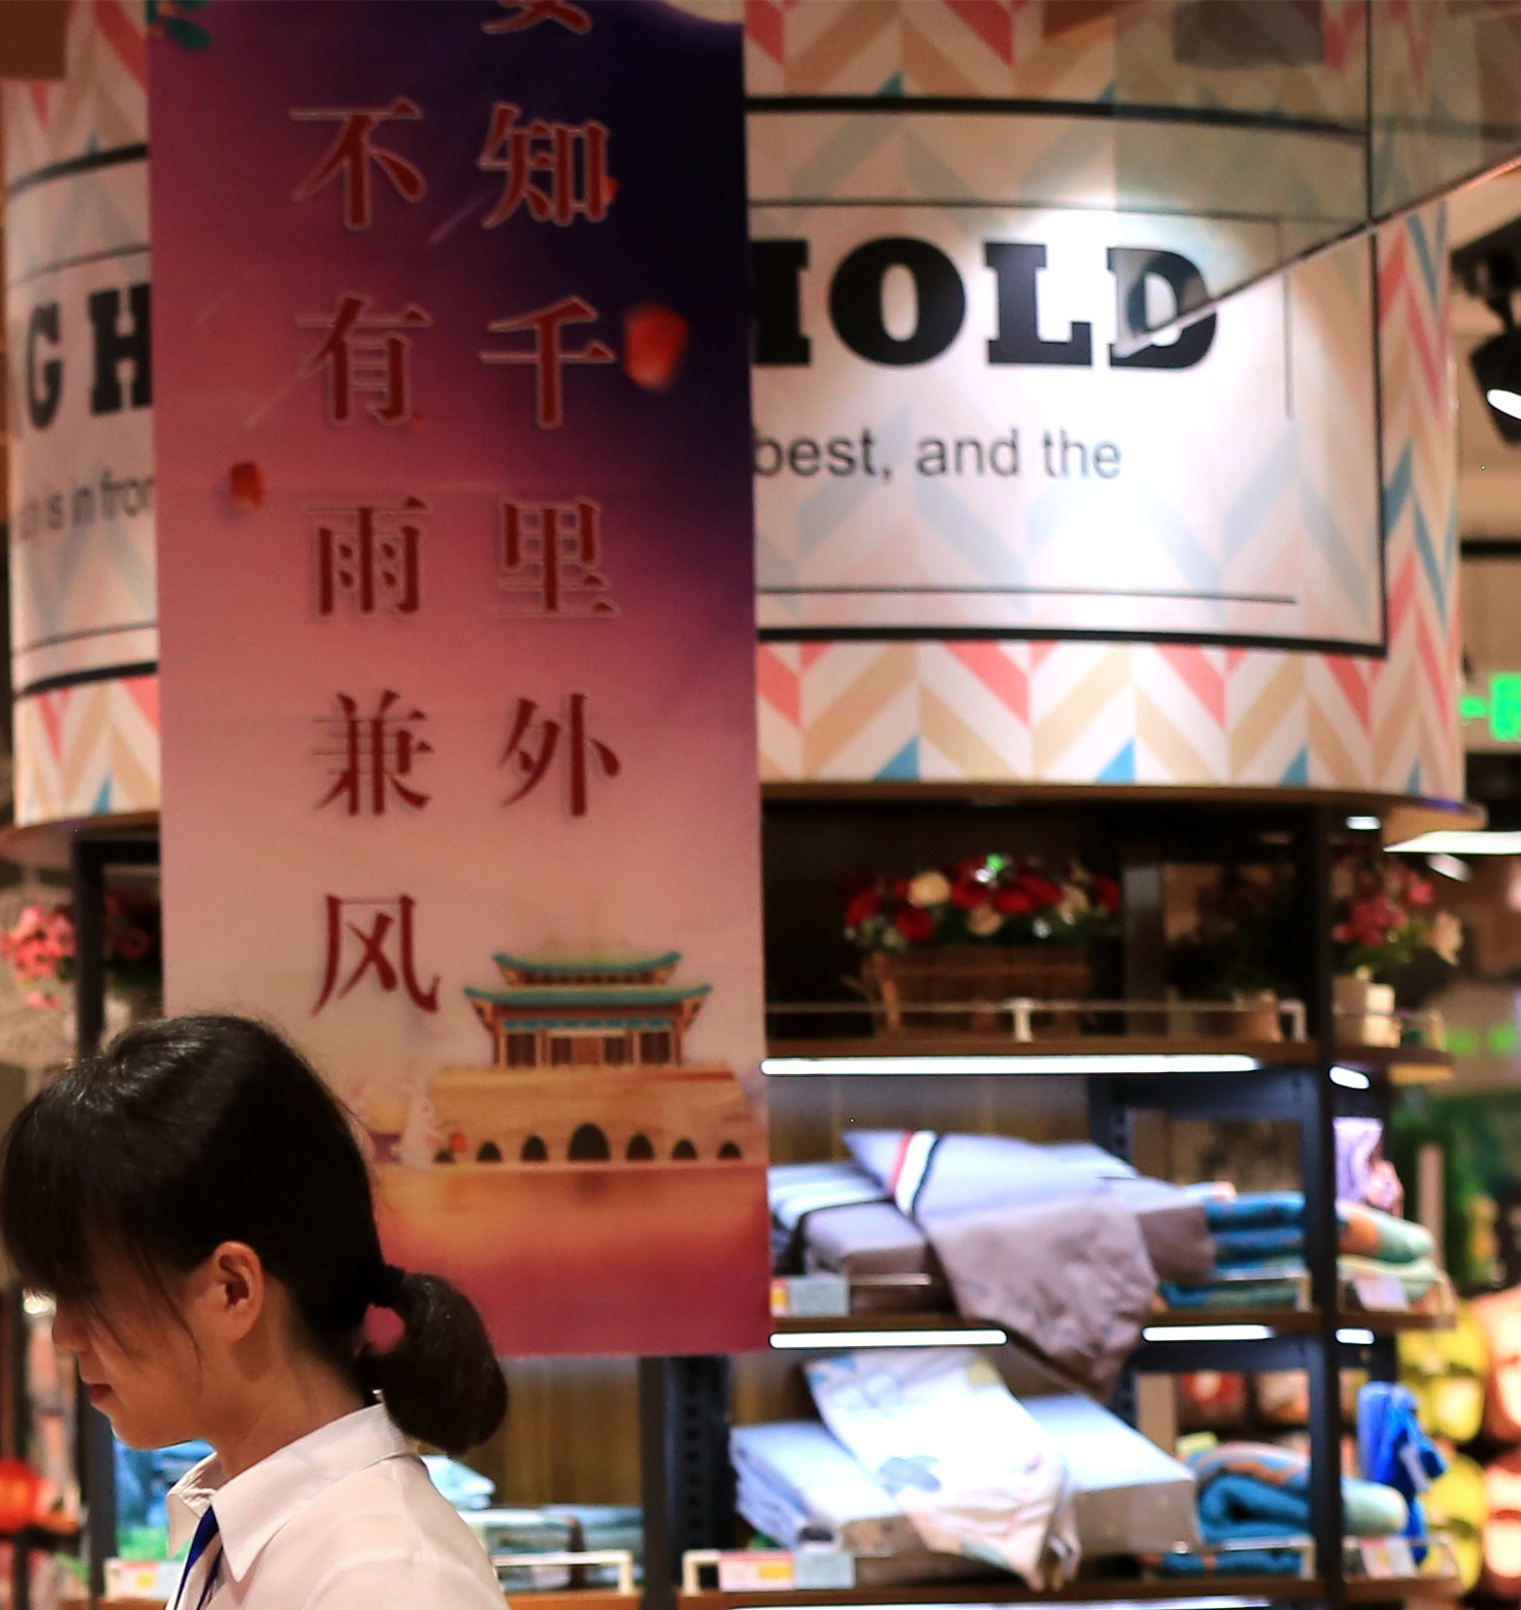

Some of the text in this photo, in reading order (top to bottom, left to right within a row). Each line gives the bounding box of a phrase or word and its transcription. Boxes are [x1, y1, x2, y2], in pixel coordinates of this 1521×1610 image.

[288, 97, 441, 1017] 不有雨兼风
[916, 424, 1019, 478] and
[1041, 426, 1122, 479] the
